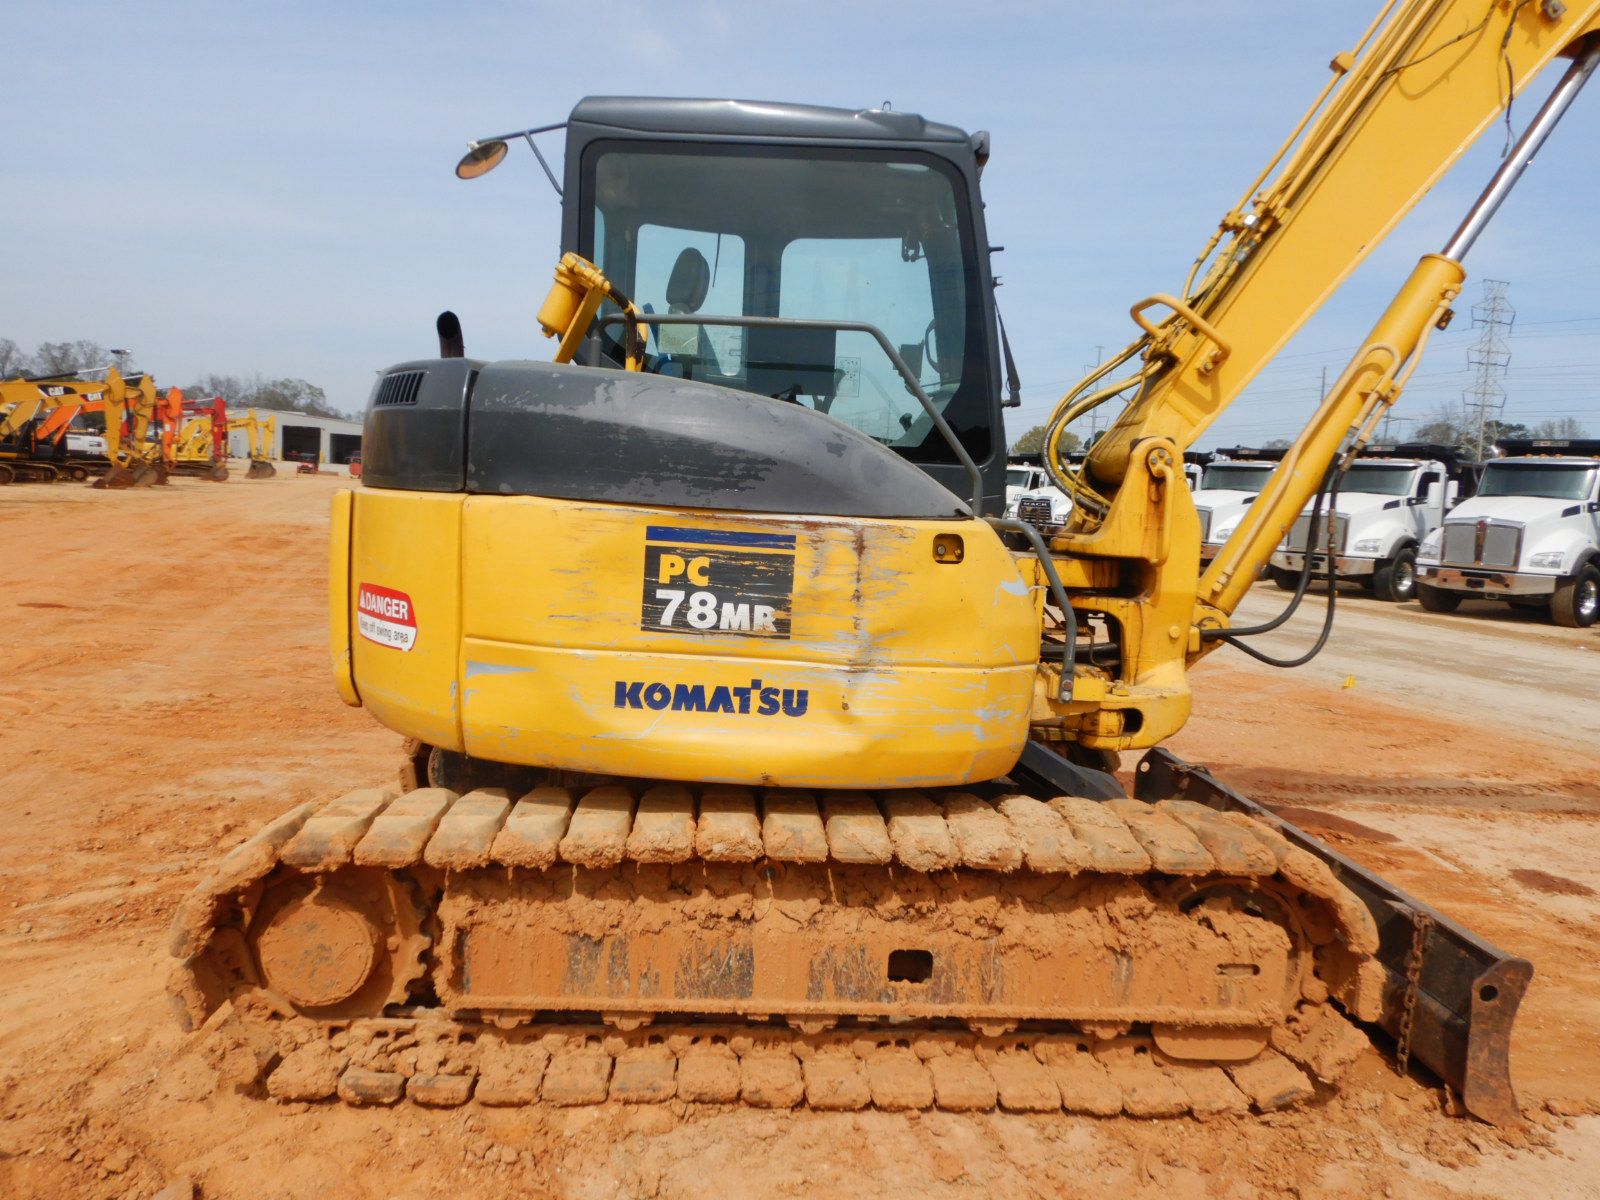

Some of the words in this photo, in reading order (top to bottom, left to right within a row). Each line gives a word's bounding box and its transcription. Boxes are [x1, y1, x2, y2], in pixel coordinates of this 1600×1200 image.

[48, 386, 64, 396] CAT
[87, 392, 102, 401] CAT
[658, 554, 711, 587] PC
[366, 591, 408, 620] DANGER
[656, 589, 777, 632] 78MR
[614, 679, 809, 717] KOMATSU
